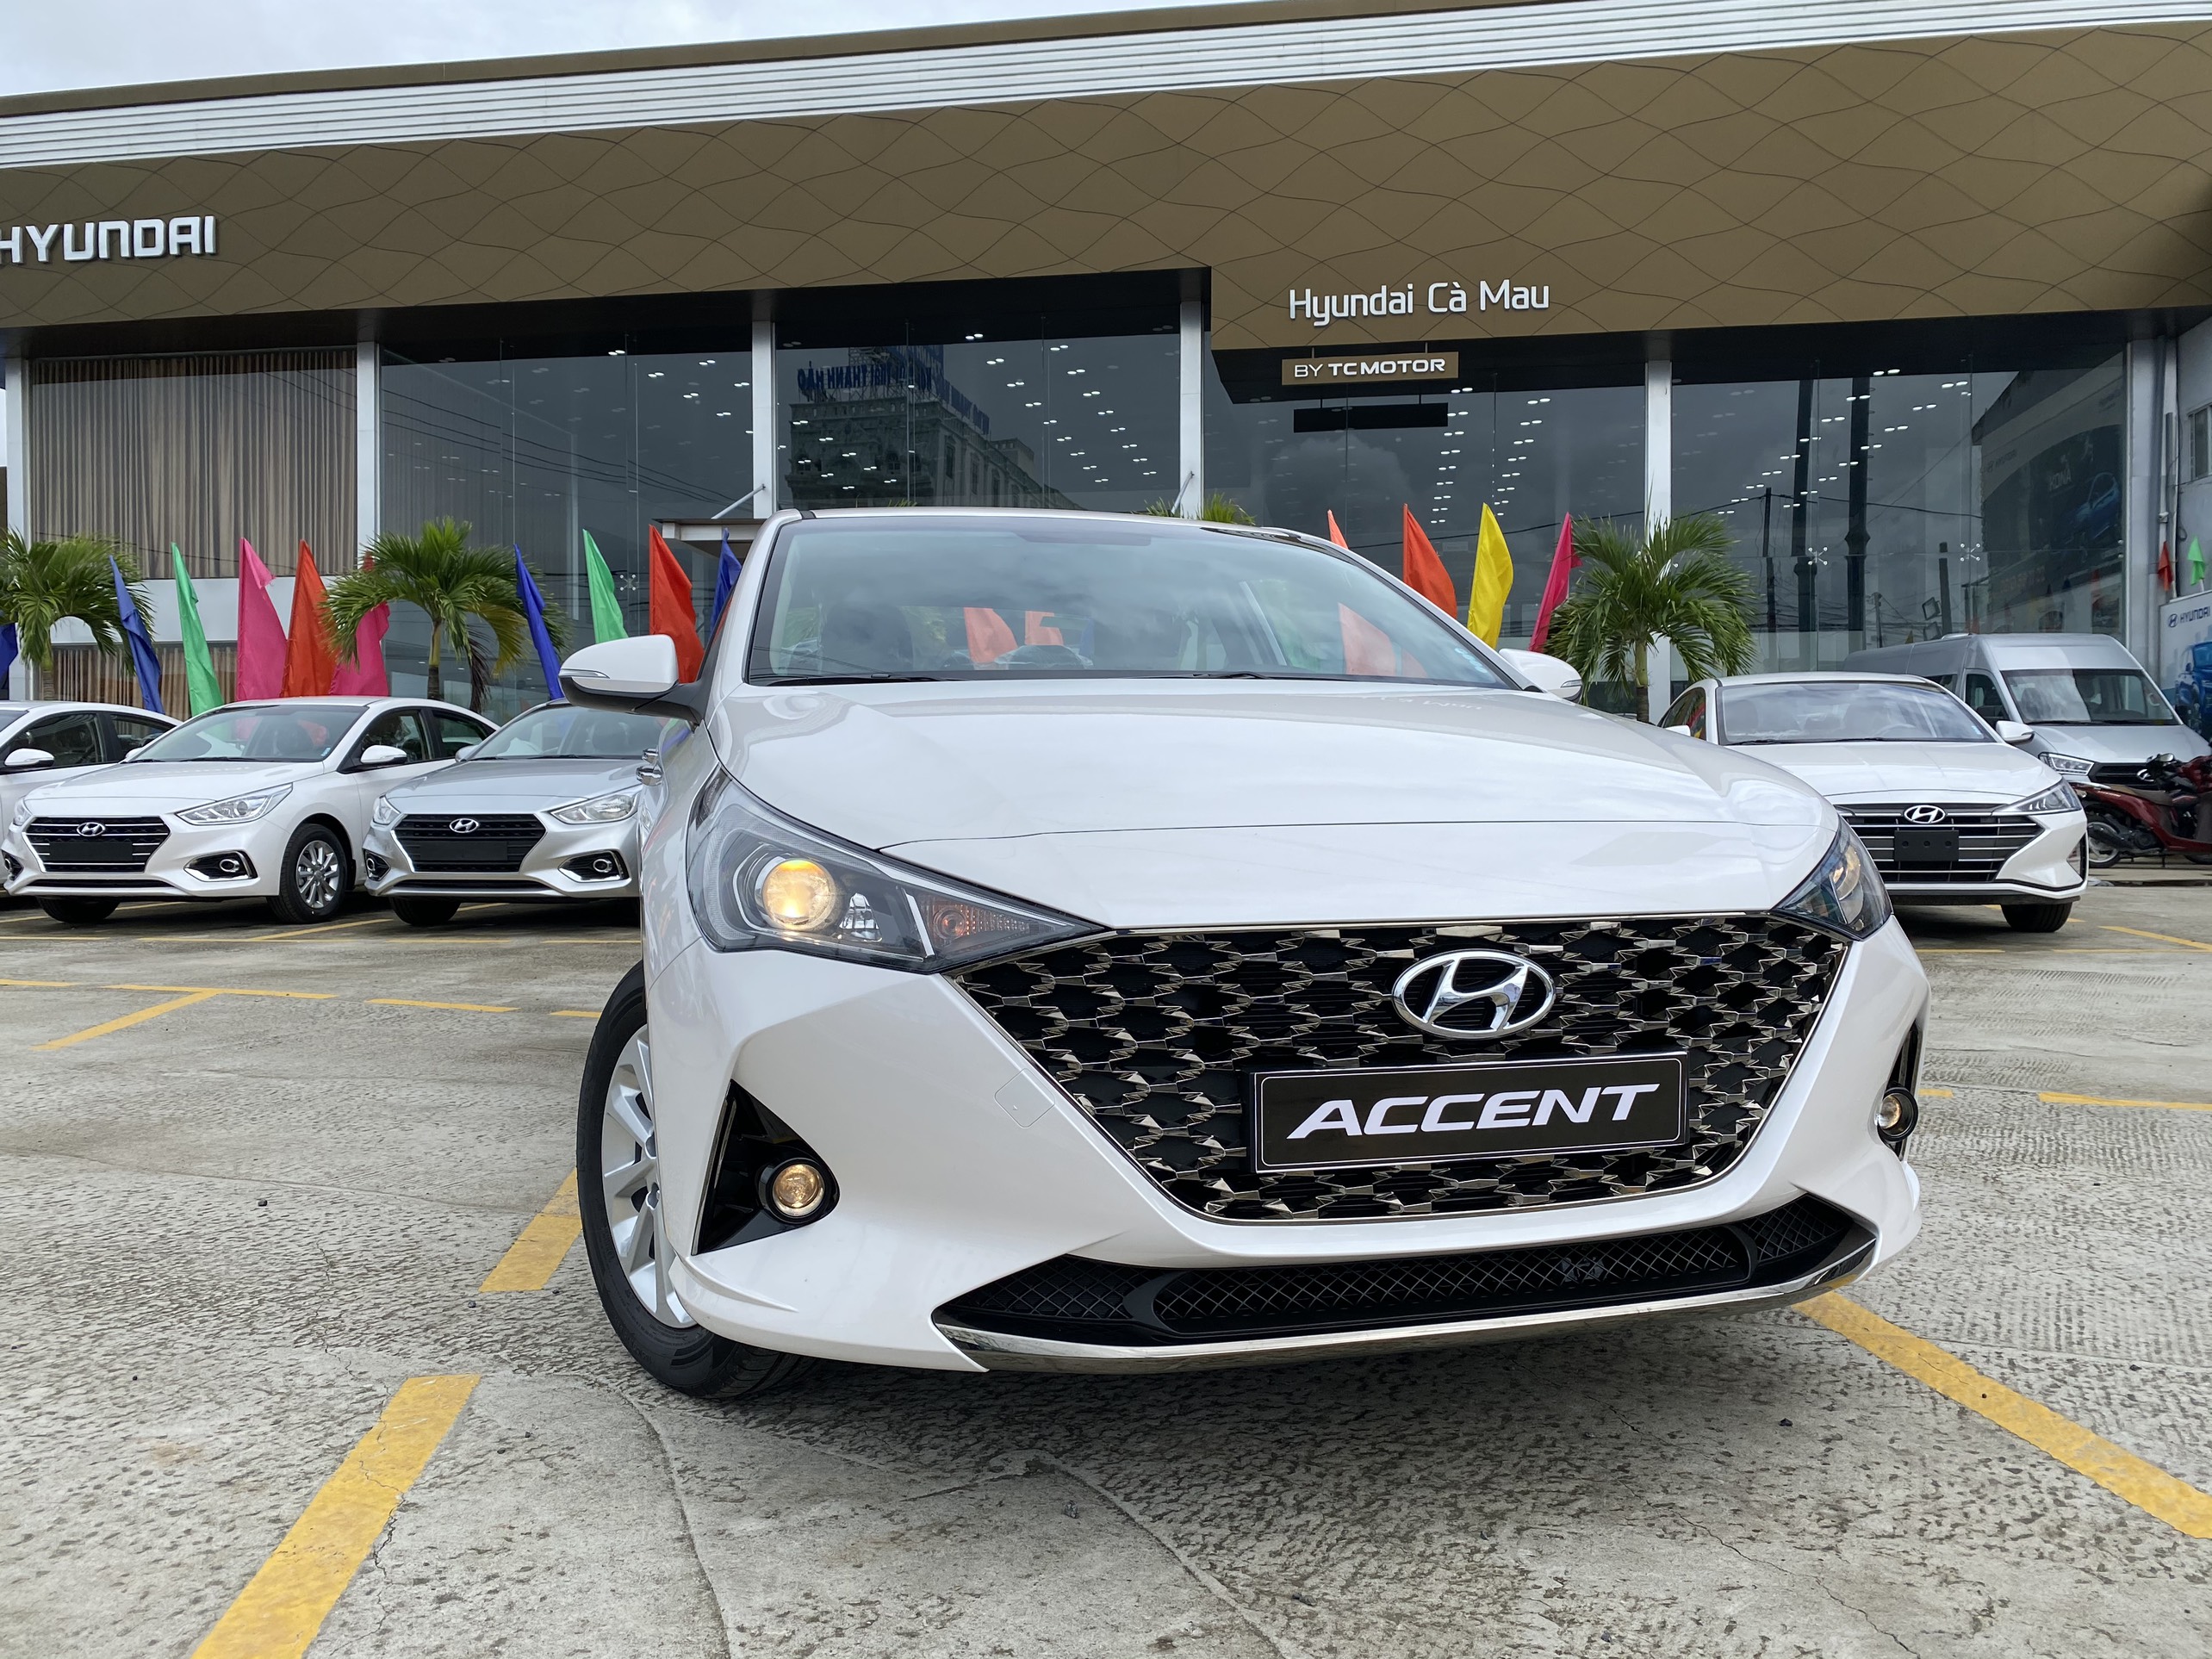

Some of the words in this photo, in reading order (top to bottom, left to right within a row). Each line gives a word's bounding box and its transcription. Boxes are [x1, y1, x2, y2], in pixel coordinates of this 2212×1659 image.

[0, 215, 216, 264] HYUNDAI
[1289, 283, 1414, 326] Hyundai
[1427, 281, 1467, 313] Cà
[1479, 279, 1550, 311] Mau
[1294, 363, 1324, 378] BY
[2180, 606, 2210, 623] HYUNDAI
[1286, 1083, 1660, 1139] ACCENT
